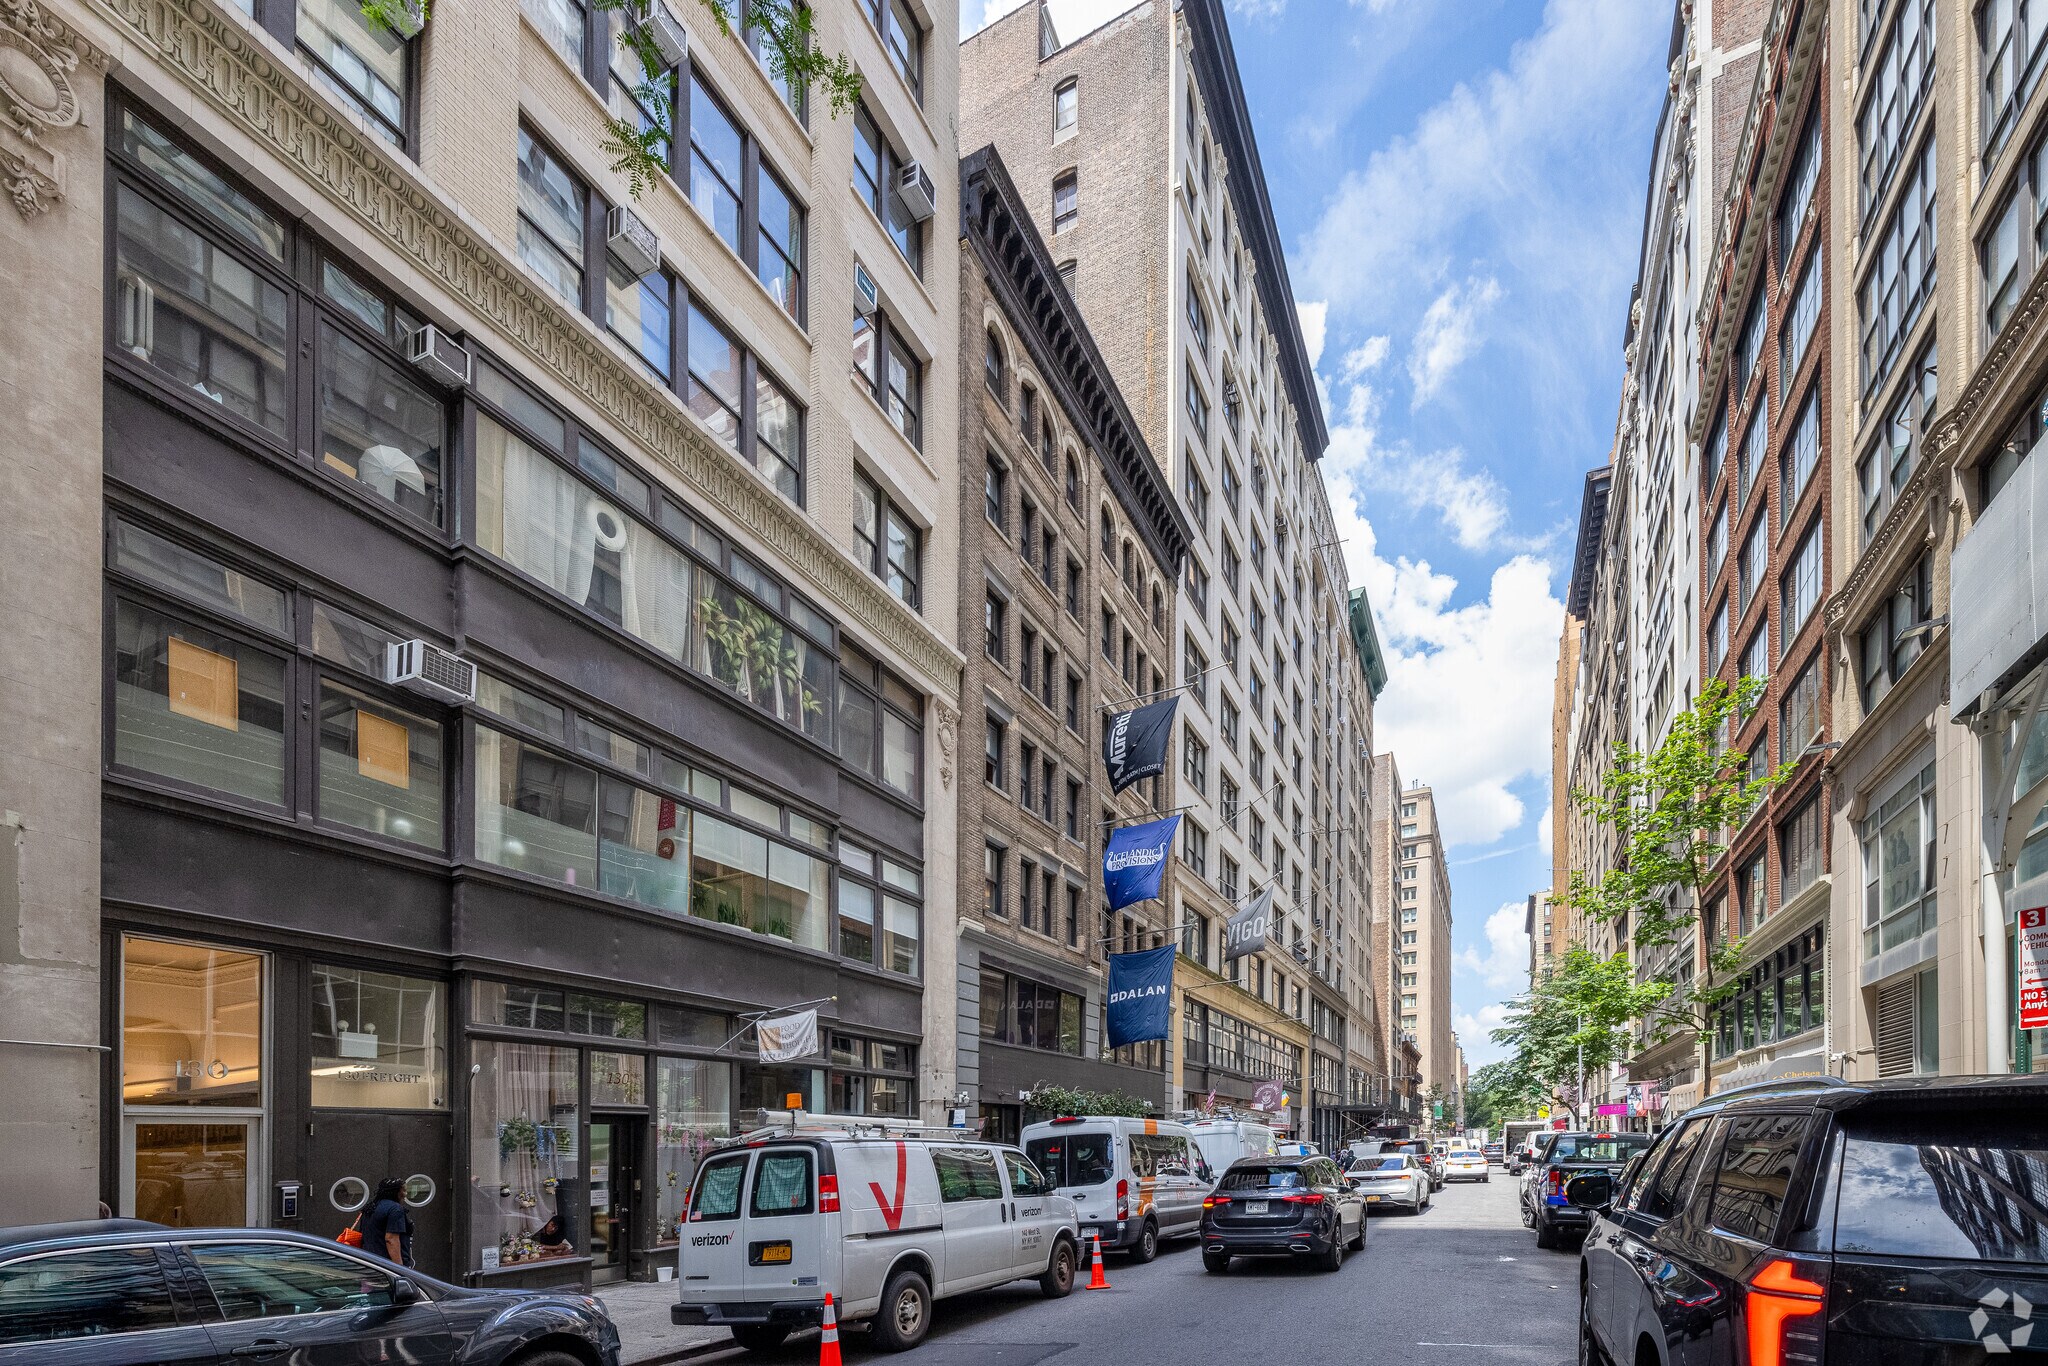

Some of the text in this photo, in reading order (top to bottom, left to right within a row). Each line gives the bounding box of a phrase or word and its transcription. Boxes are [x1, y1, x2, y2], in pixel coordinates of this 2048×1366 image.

[1140, 763, 1162, 773] CLOSET
[1113, 848, 1159, 861] ICELANDIC
[1111, 855, 1159, 870] PROVISIONS
[2026, 910, 2040, 927] 3
[2023, 966, 2041, 975] 8am
[1118, 984, 1166, 1002] DALAN
[2024, 990, 2048, 1001] NO S
[2024, 999, 2048, 1011] Anyt
[781, 1022, 801, 1032] FOOD
[175, 1058, 229, 1080] 130
[338, 1070, 421, 1084] 130 FREIGHT
[606, 1072, 630, 1085] 130
[1020, 1206, 1042, 1218] verizon
[691, 1232, 729, 1247] verizon
